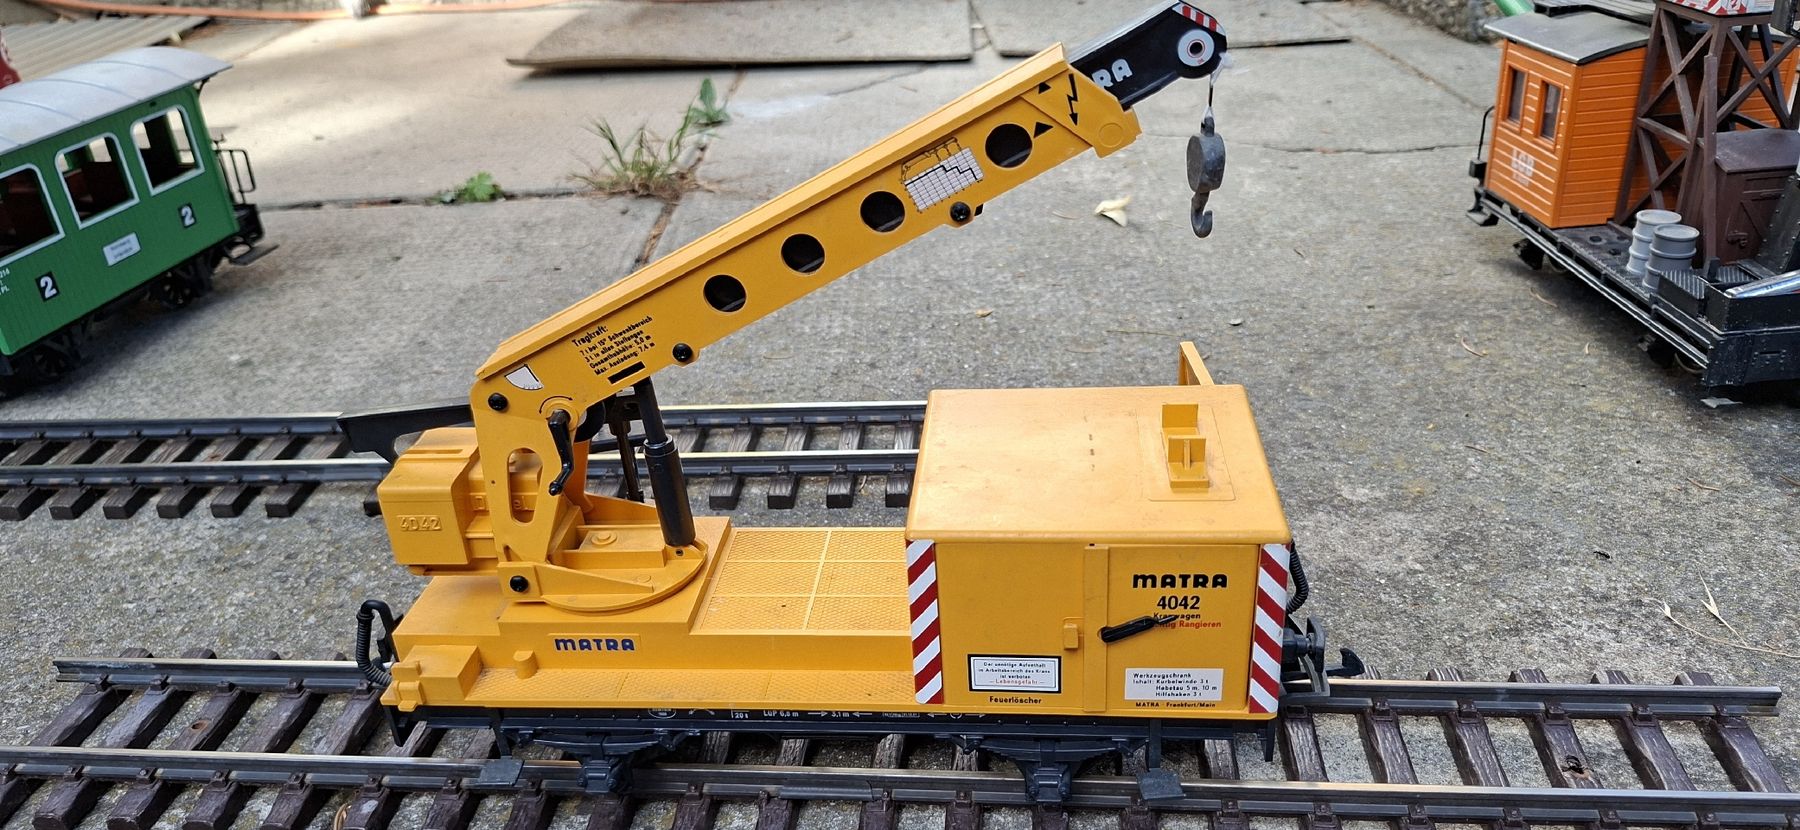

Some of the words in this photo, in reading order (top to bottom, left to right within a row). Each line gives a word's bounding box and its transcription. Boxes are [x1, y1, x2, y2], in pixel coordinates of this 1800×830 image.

[181, 206, 195, 226] 2
[40, 276, 57, 299] 2
[572, 326, 608, 347] Tragkraft:
[589, 344, 597, 353] bei
[608, 316, 652, 341] Schwenkbereich
[601, 345, 614, 354] allen
[614, 330, 644, 347] Stellungen
[608, 351, 639, 368] Ausladung:
[400, 516, 442, 530] 4042
[1132, 574, 1228, 588] MATRA
[1157, 596, 1200, 610] 4042
[1180, 620, 1222, 629] Rangieren
[554, 638, 635, 651] MATRA
